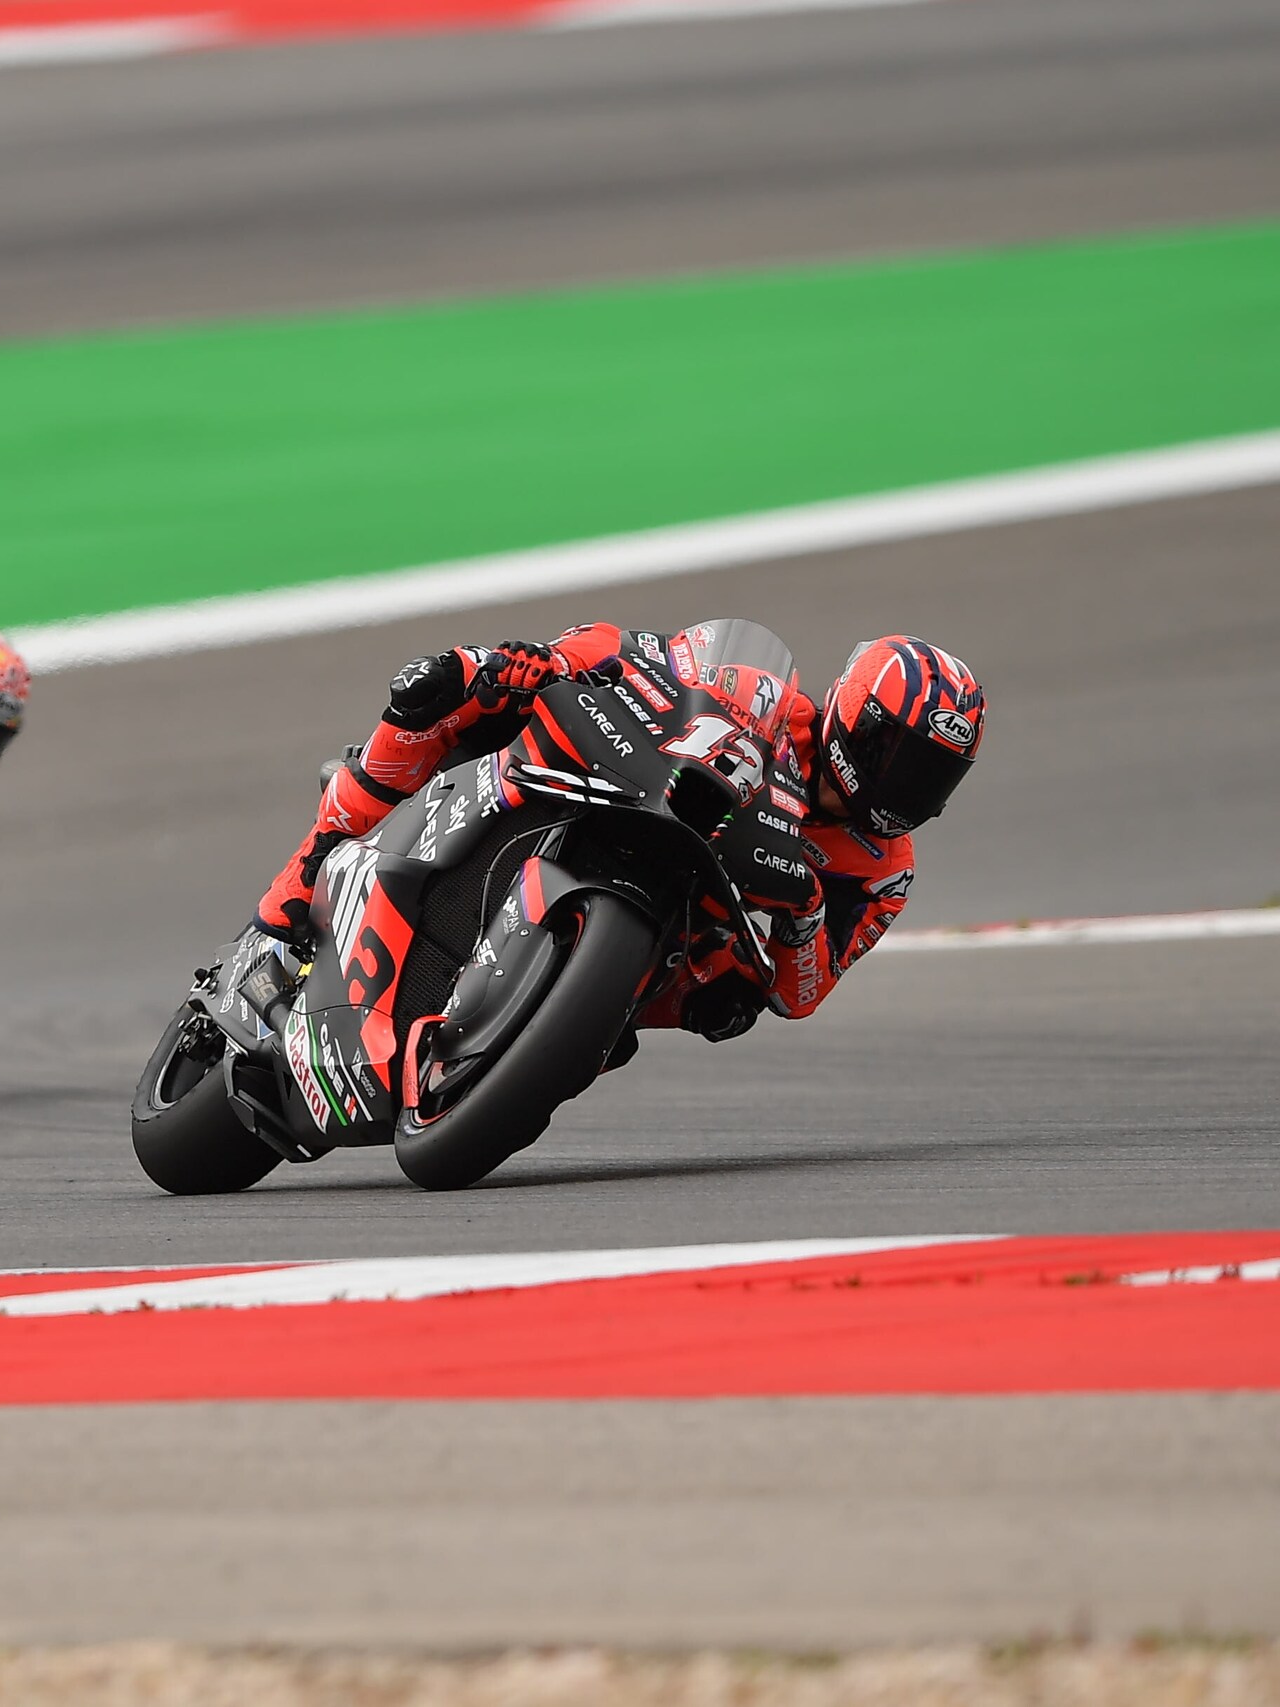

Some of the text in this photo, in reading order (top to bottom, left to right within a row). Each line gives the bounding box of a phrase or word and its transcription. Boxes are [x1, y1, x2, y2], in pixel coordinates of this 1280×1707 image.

[630, 673, 668, 707] BS
[648, 669, 678, 697] Marsh
[614, 685, 651, 722] CASE
[578, 693, 633, 757] CAREAR
[933, 715, 972, 740] Arai
[659, 714, 766, 807] 12
[830, 739, 859, 794] aprilia
[772, 788, 800, 812] BS
[757, 811, 788, 833] CASE
[753, 847, 806, 880] CAREAR
[254, 972, 279, 1000] SC
[792, 938, 824, 1006] aprilia
[290, 1025, 328, 1130] Castrol
[321, 1023, 344, 1097] CASE
